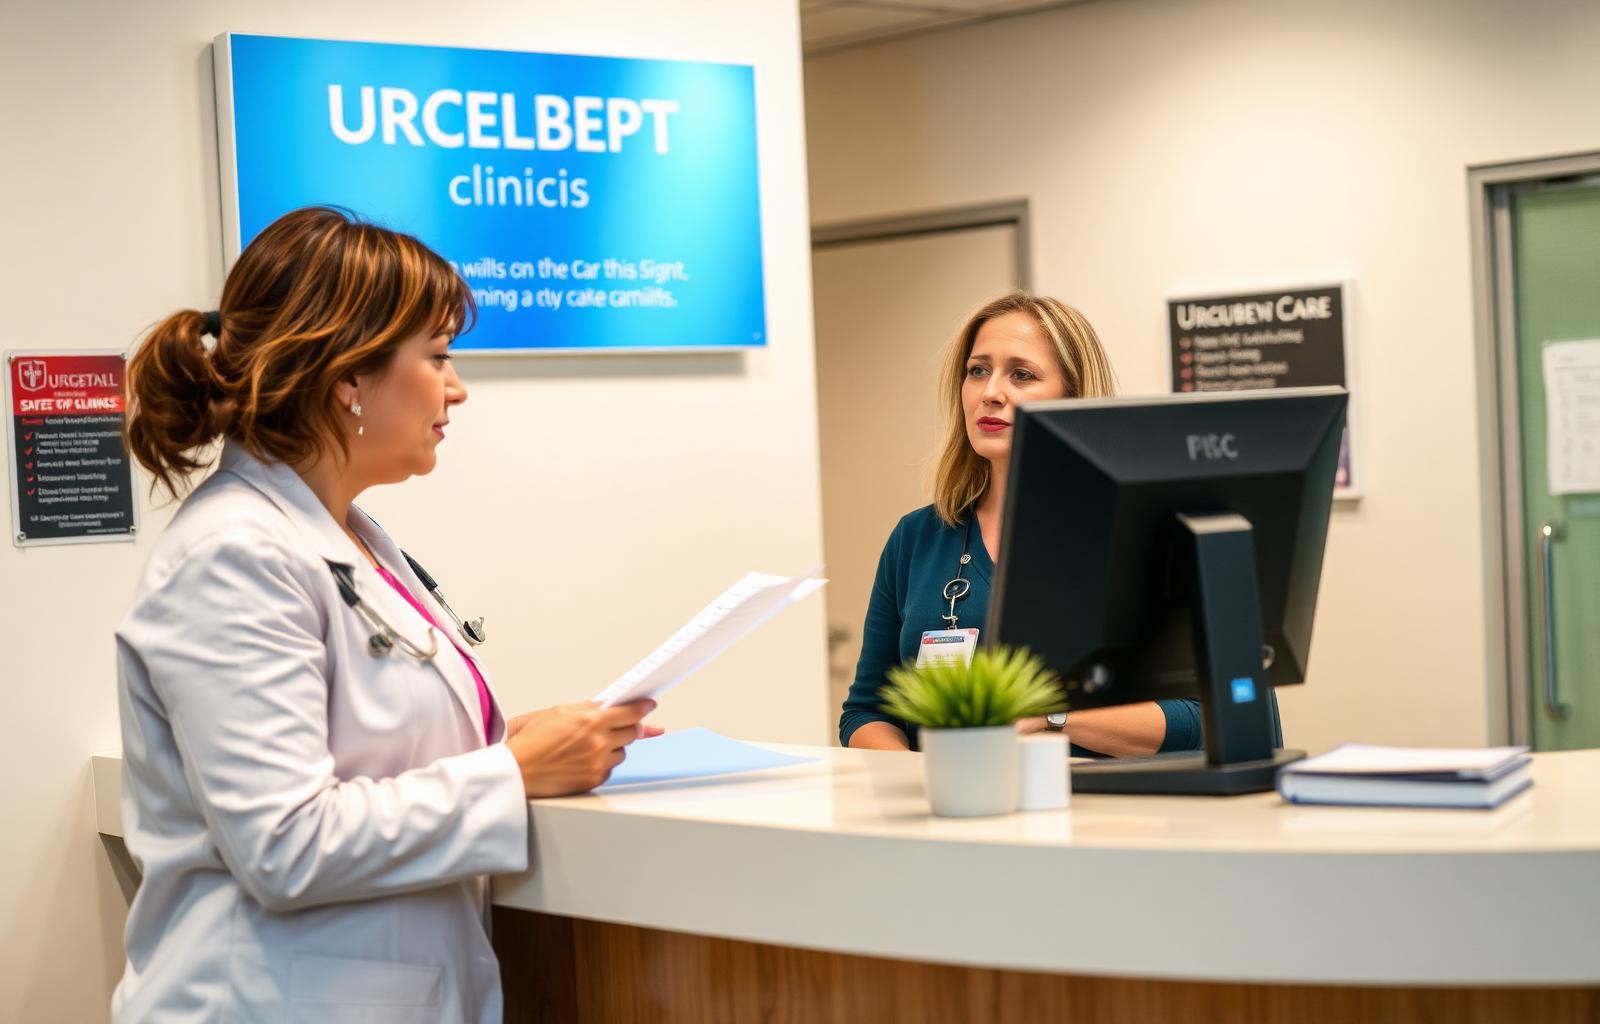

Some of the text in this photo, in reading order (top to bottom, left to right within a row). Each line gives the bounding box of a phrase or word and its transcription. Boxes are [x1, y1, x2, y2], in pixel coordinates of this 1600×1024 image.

[328, 83, 679, 154] URCELBEPT
[449, 164, 590, 208] clinicis
[510, 261, 534, 279] on
[538, 257, 568, 280] the
[571, 260, 601, 280] Car
[521, 290, 533, 307] a
[1276, 295, 1332, 322] CARE
